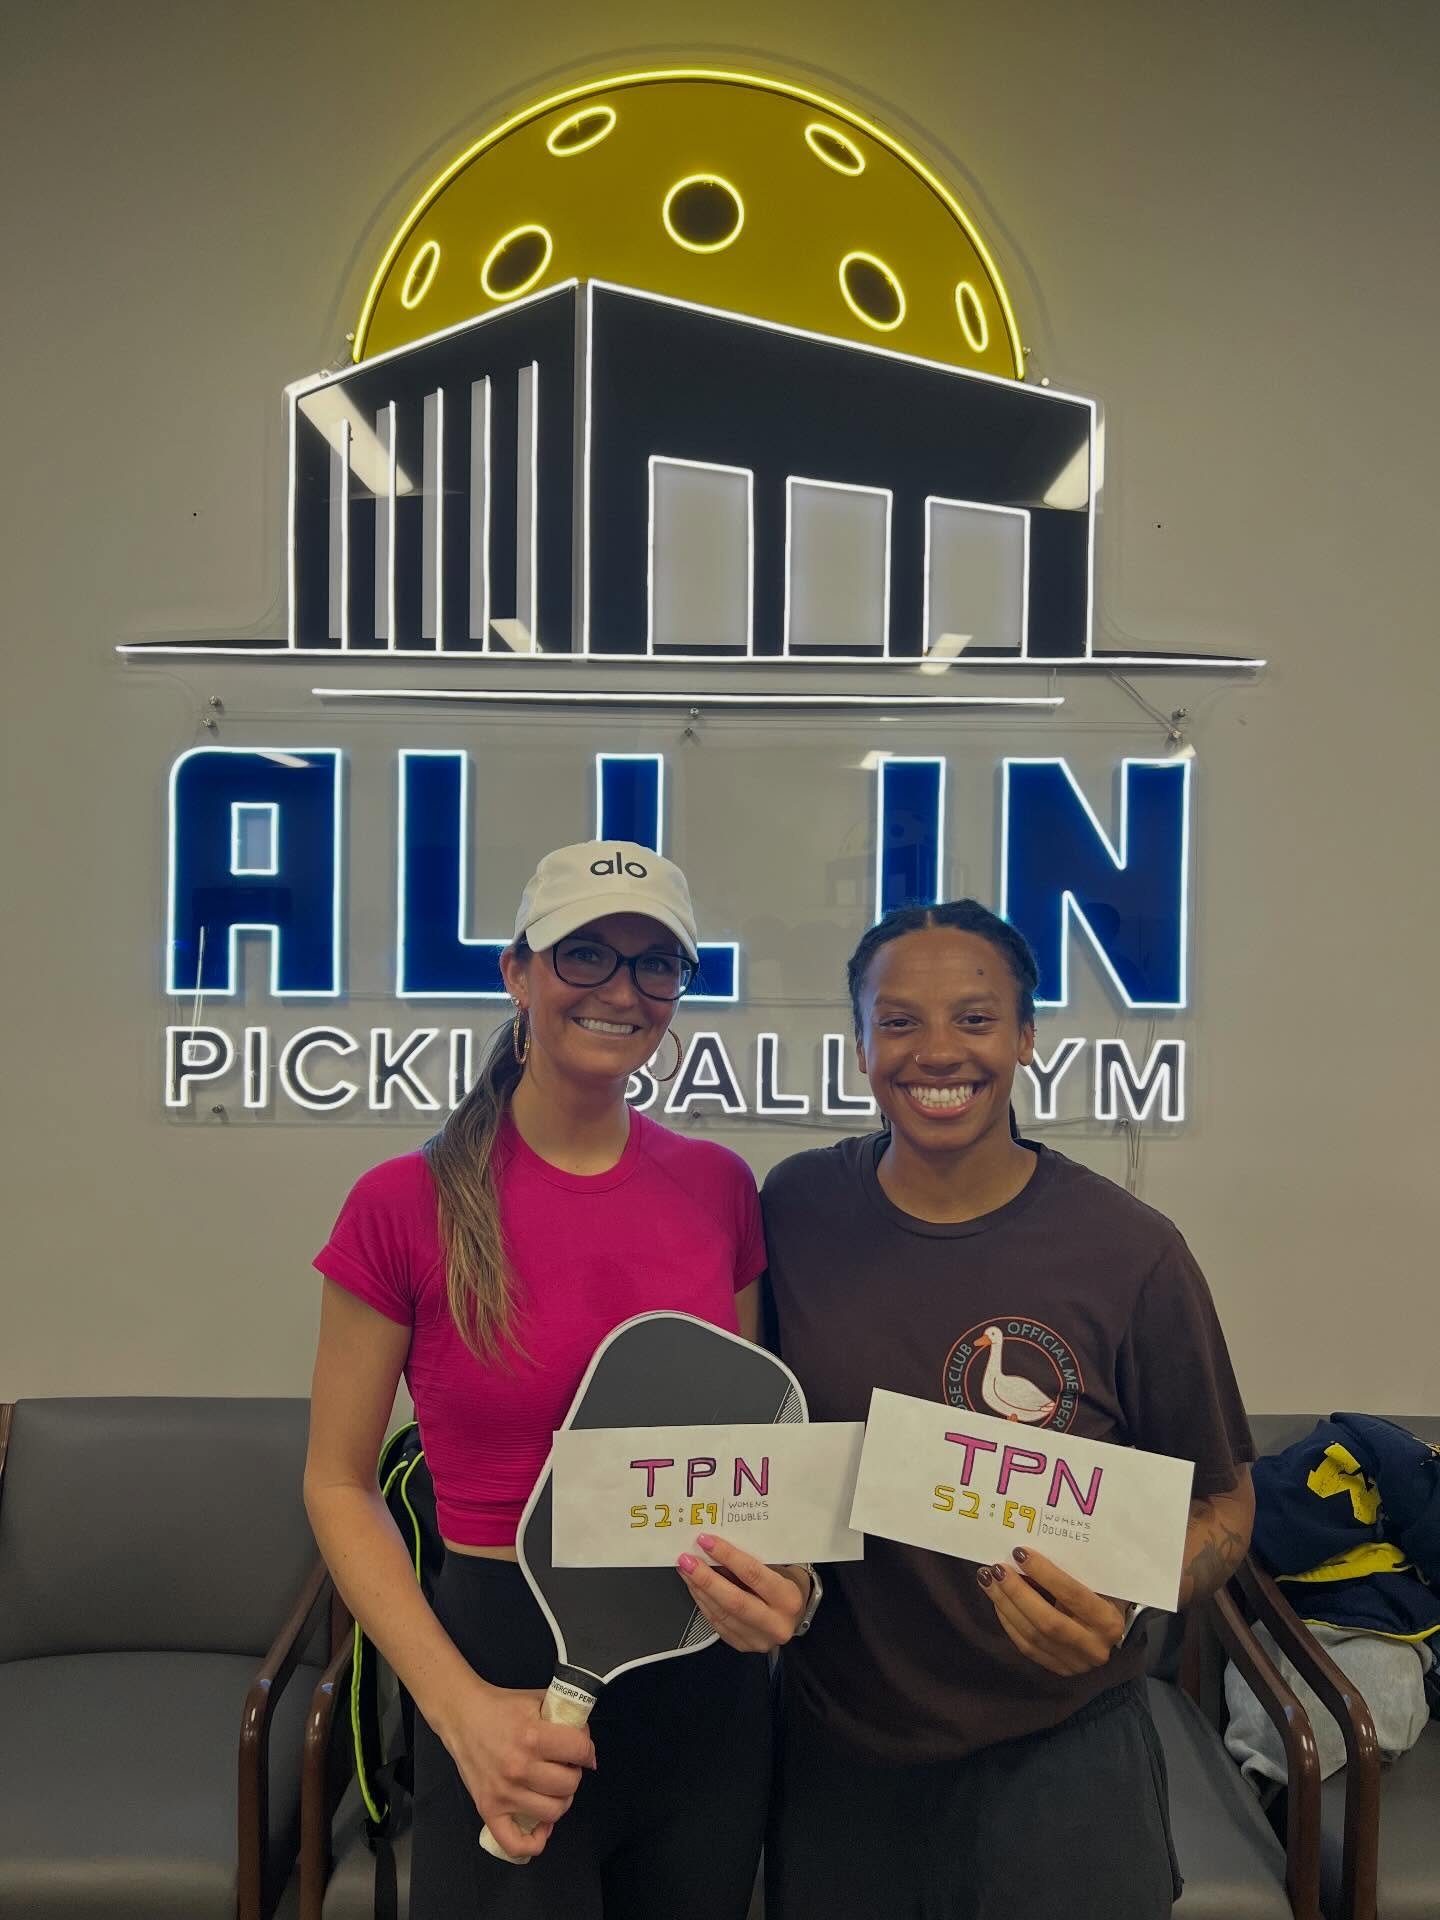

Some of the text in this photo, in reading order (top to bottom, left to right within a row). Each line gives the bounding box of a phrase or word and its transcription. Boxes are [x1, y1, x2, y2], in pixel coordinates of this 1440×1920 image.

[590, 851, 648, 878] alo
[875, 756, 1191, 1009] IN
[1017, 1037, 1186, 1122] YM
[949, 1343, 972, 1382] CLUB
[1007, 1321, 1069, 1368] OFFICIAL
[630, 1457, 769, 1498] TPN
[945, 1432, 1103, 1516] TPN
[727, 1500, 769, 1509] WOMENS
[727, 1511, 769, 1523] DOUBLES
[1044, 1513, 1092, 1530] WOMENS
[1041, 1522, 1091, 1544] DOUBLES
